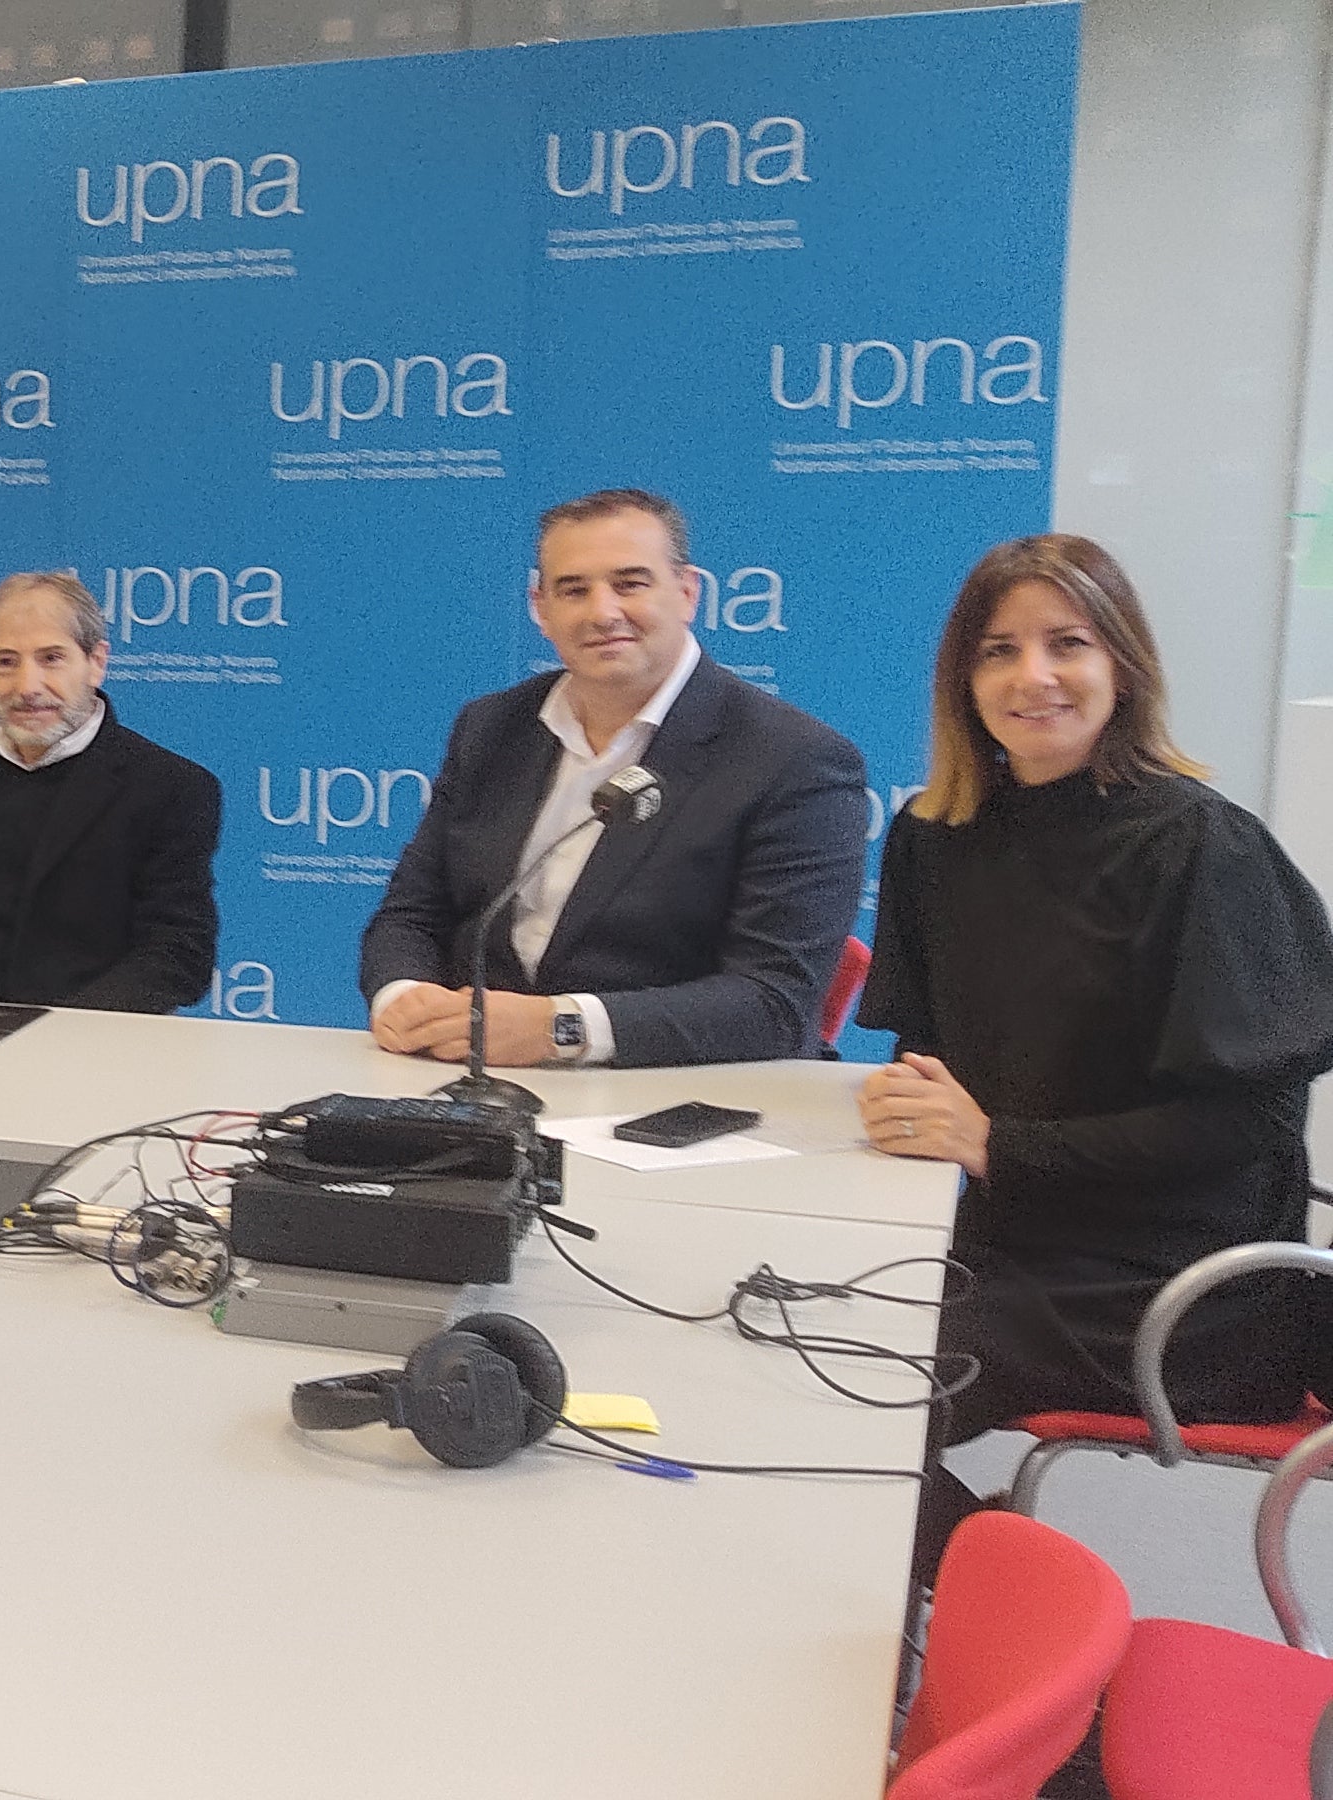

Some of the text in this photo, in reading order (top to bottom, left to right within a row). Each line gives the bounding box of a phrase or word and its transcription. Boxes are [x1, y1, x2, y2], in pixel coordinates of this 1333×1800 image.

[76, 153, 304, 243] upna
[546, 115, 812, 215] upna
[270, 352, 513, 441] upna
[770, 334, 1050, 430] upna
[259, 766, 434, 845] upn
